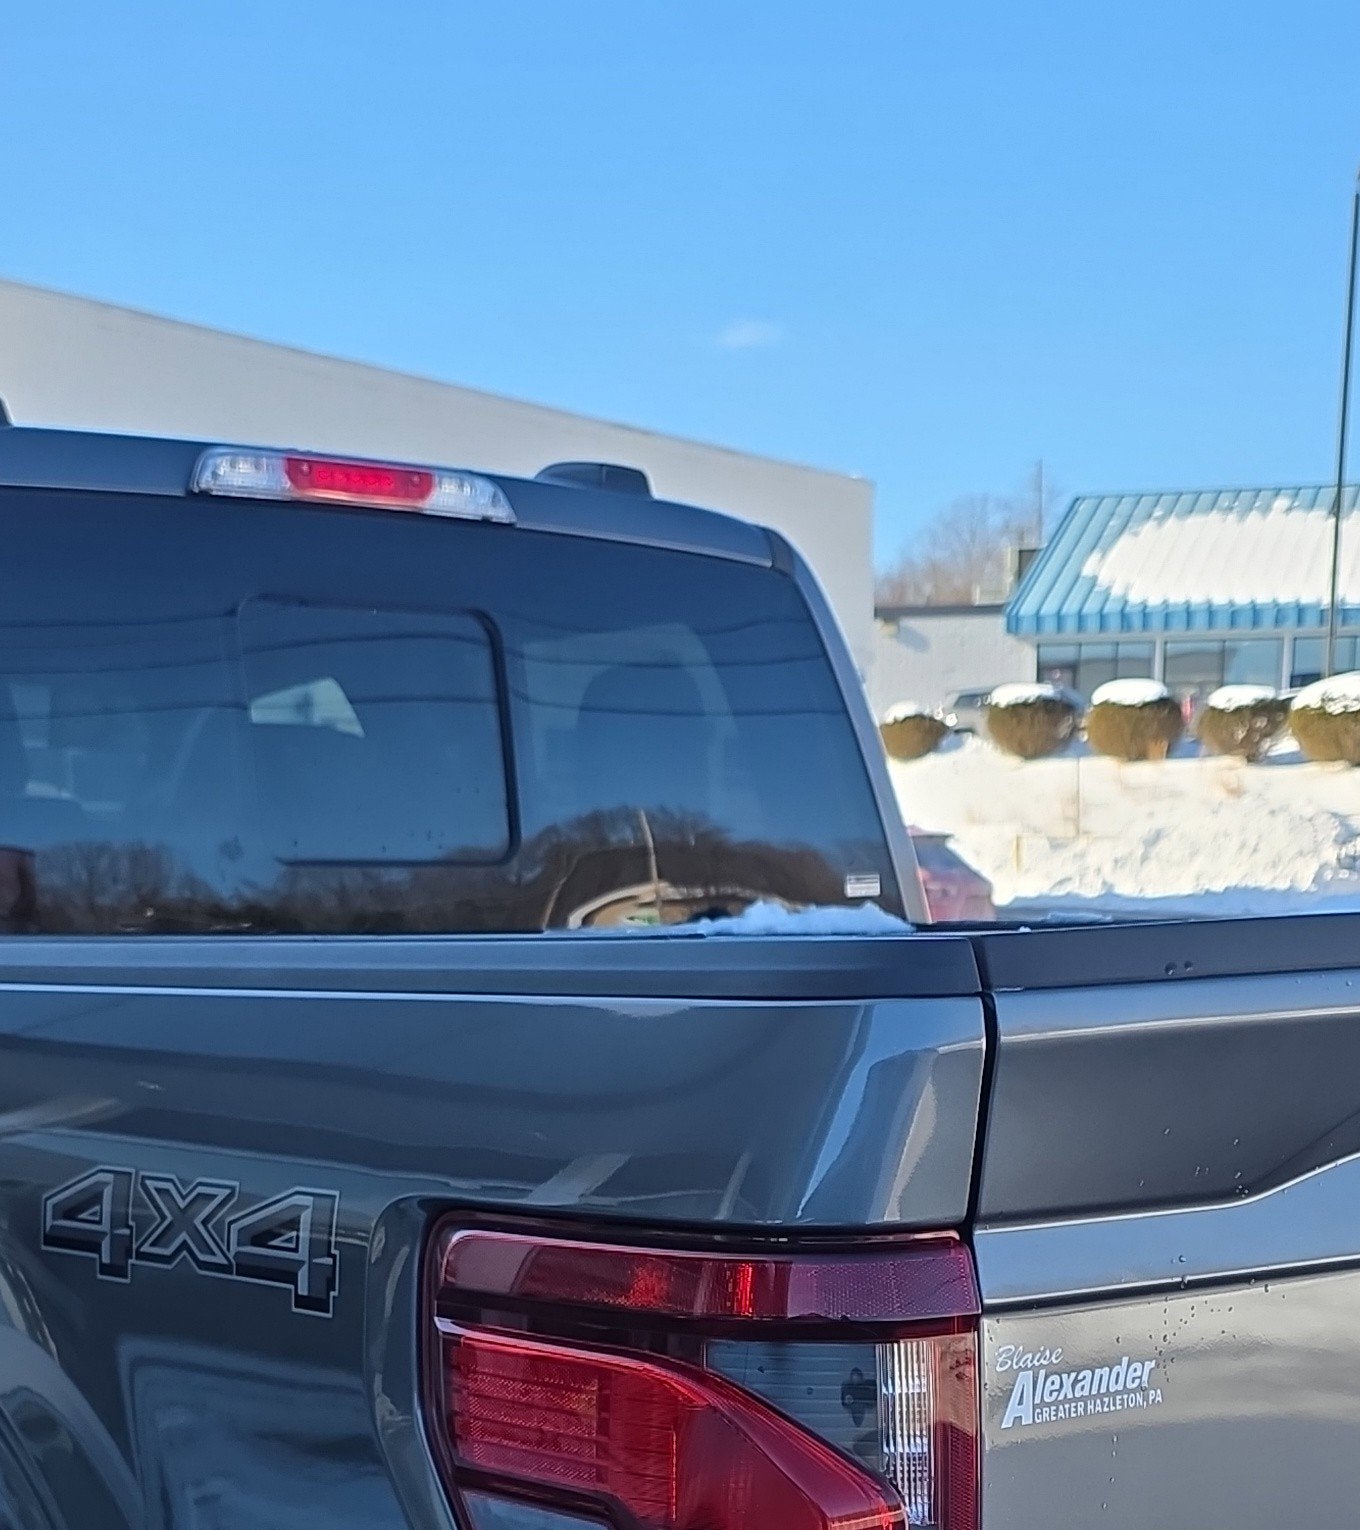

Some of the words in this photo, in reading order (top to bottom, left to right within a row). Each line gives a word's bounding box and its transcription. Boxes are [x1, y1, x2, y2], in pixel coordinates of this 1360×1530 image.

[995, 1345, 1064, 1372] Blaise
[1001, 1356, 1157, 1429] Alexander
[1034, 1401, 1085, 1424] GREATER
[1087, 1391, 1148, 1416] HAZLETON,
[1148, 1388, 1163, 1406] PA
